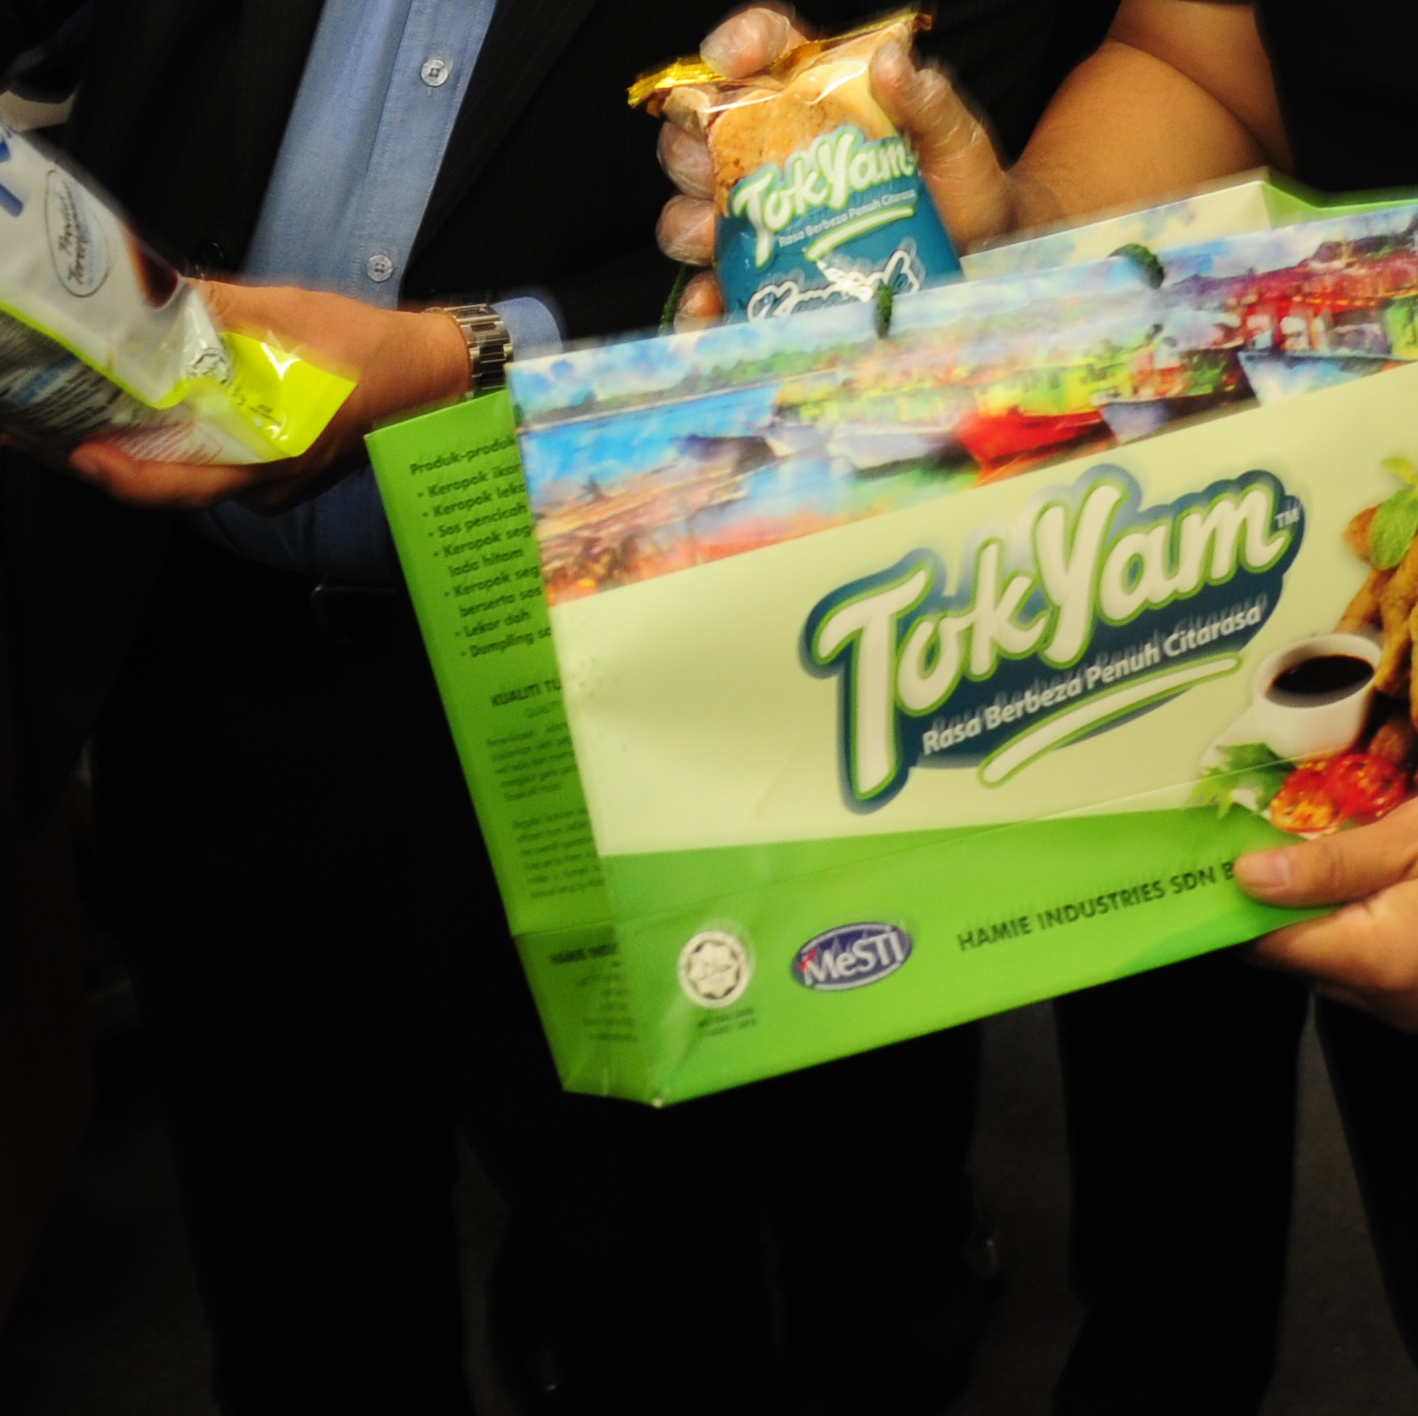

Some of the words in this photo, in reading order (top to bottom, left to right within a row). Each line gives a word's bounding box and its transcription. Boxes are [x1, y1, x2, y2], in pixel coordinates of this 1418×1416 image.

[922, 714, 981, 756] Rasa
[985, 677, 1082, 732] Berbeza
[1085, 642, 1160, 691] Penuh
[1163, 605, 1262, 659] Citarasa
[957, 915, 1032, 952] HAMIE
[1036, 880, 1166, 932] INDUSTRIES
[1169, 865, 1218, 896] SDN
